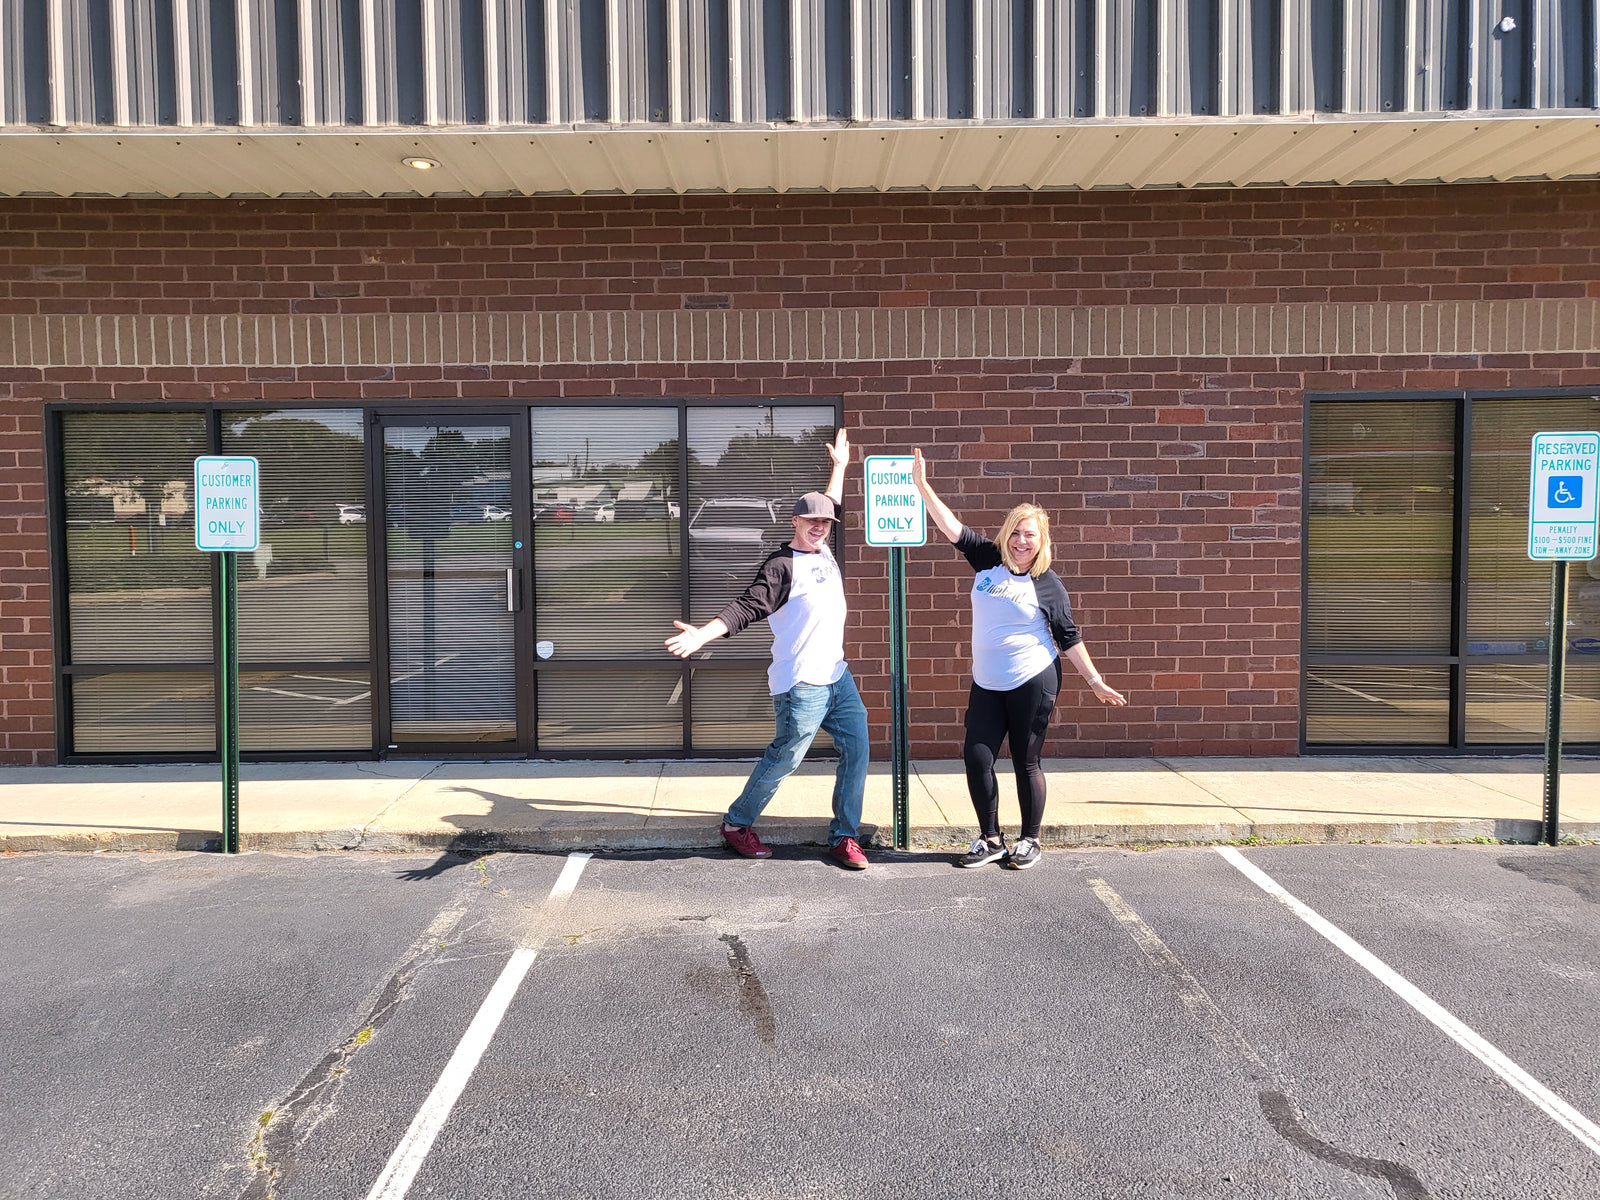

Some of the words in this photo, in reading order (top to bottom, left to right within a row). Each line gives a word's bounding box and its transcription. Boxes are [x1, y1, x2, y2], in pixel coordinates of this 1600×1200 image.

[1538, 442, 1596, 455] RESERVED
[1541, 459, 1592, 471] PARKING
[201, 474, 252, 487] CUSTOMER
[871, 472, 915, 485] CUSTOME
[206, 497, 248, 510] PARKING
[875, 494, 916, 507] PARKING
[208, 520, 246, 534] ONLY
[877, 517, 914, 530] ONLY
[1549, 525, 1578, 534] PENALTY
[1577, 536, 1592, 544] FINE
[1574, 546, 1591, 554] ZONE
